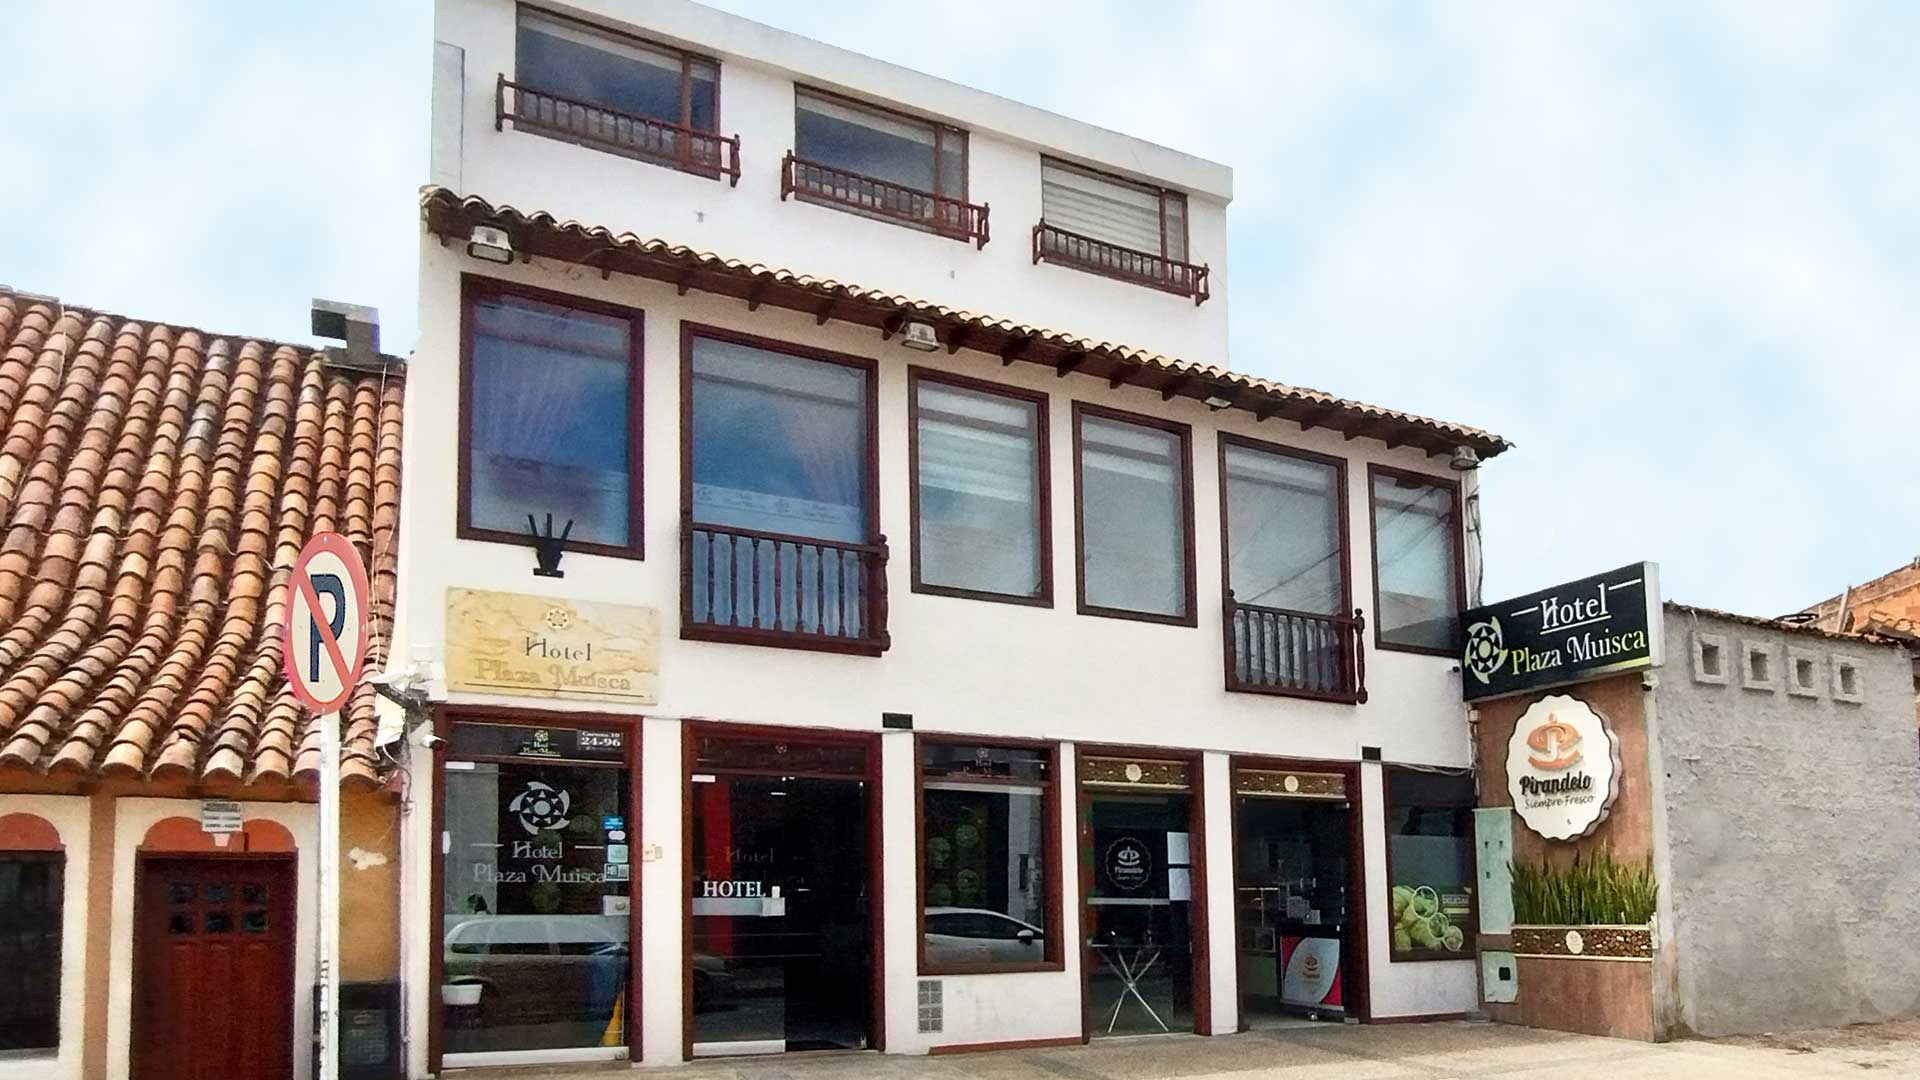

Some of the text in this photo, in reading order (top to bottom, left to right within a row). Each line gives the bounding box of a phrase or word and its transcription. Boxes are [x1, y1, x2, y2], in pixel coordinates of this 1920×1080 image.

[1540, 582, 1609, 630] Hotel
[310, 573, 346, 683] P
[525, 636, 592, 662] Hotel
[1511, 628, 1647, 676] Plaza Muisca
[474, 658, 631, 690] Plaza Muisca
[581, 737, 621, 747] 24-96
[1519, 770, 1592, 796] Pirandelo
[1525, 794, 1595, 810] Siempre Fresco
[512, 840, 563, 859] Hotel
[473, 863, 605, 884] Plaza Muisca
[703, 880, 766, 897] HOTEL
